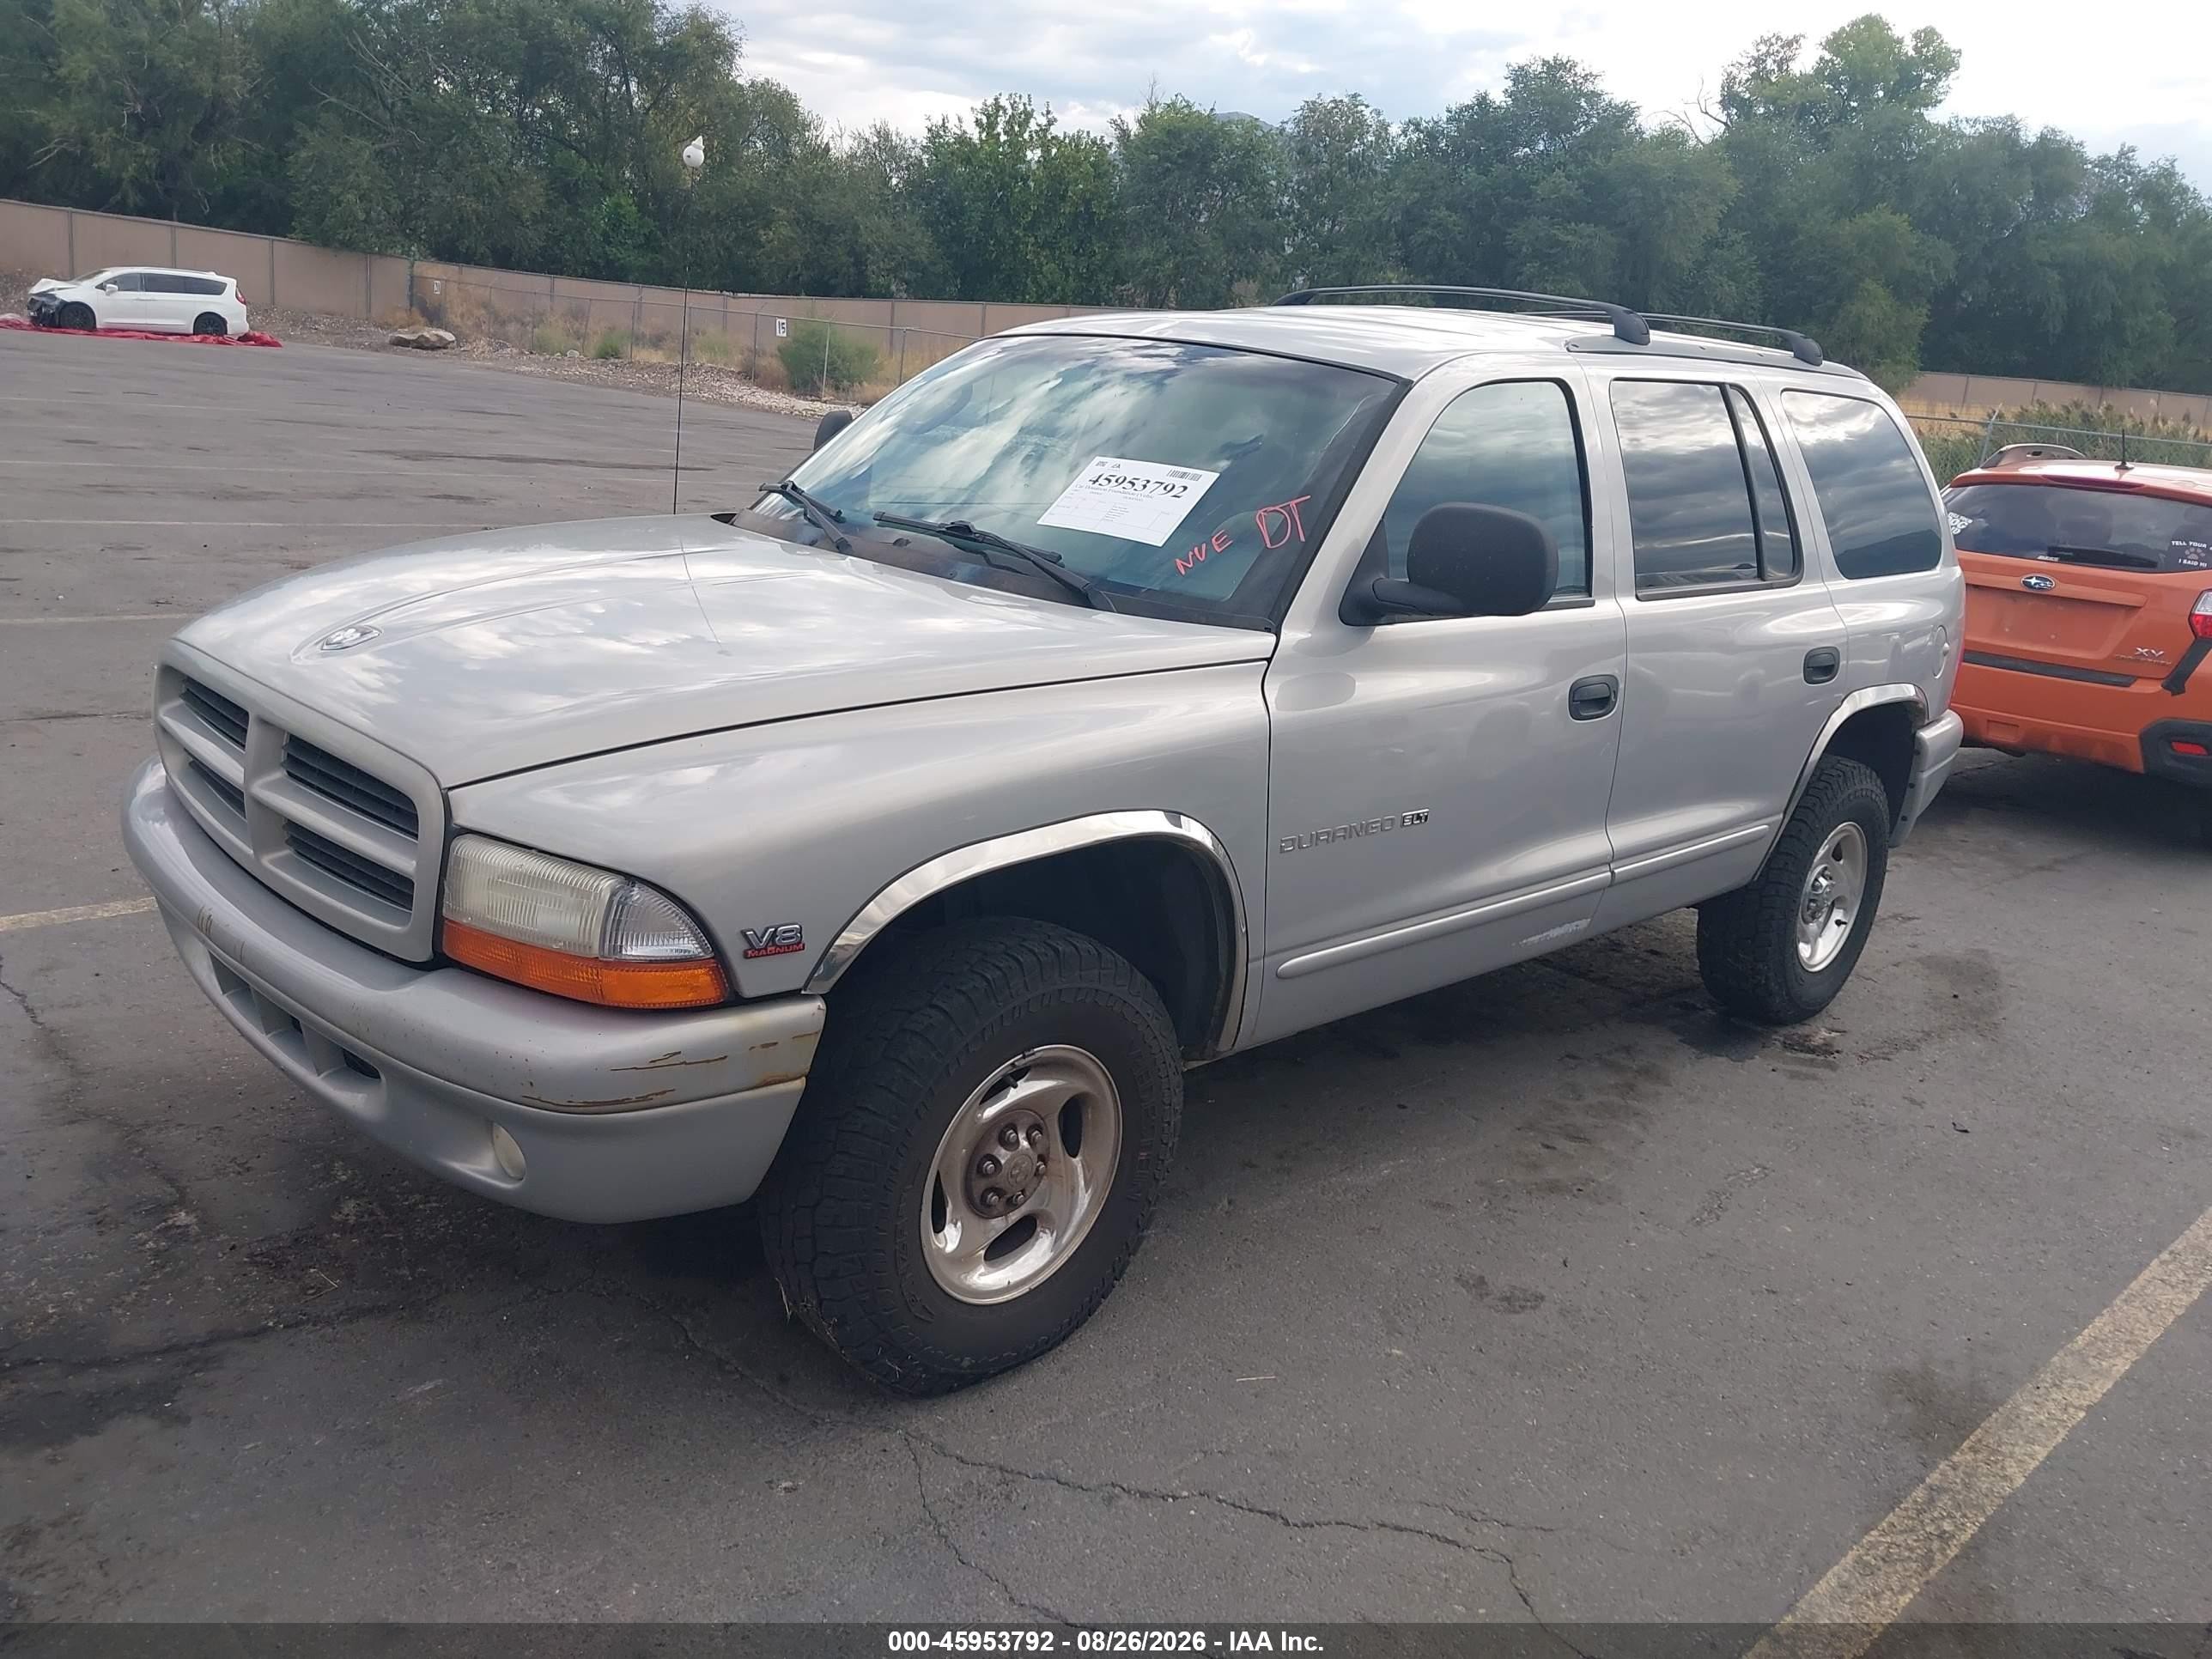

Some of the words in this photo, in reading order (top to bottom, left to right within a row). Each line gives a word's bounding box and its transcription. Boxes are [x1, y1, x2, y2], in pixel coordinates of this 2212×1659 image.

[777, 319, 787, 335] 15
[1088, 473, 1188, 499] 45953792
[1256, 495, 1311, 549] DT
[2135, 647, 2165, 658] XV
[1279, 815, 1395, 854] DURANGO
[1401, 809, 1429, 828] SLT
[740, 922, 803, 950] V8
[747, 944, 804, 957] MAGNUM
